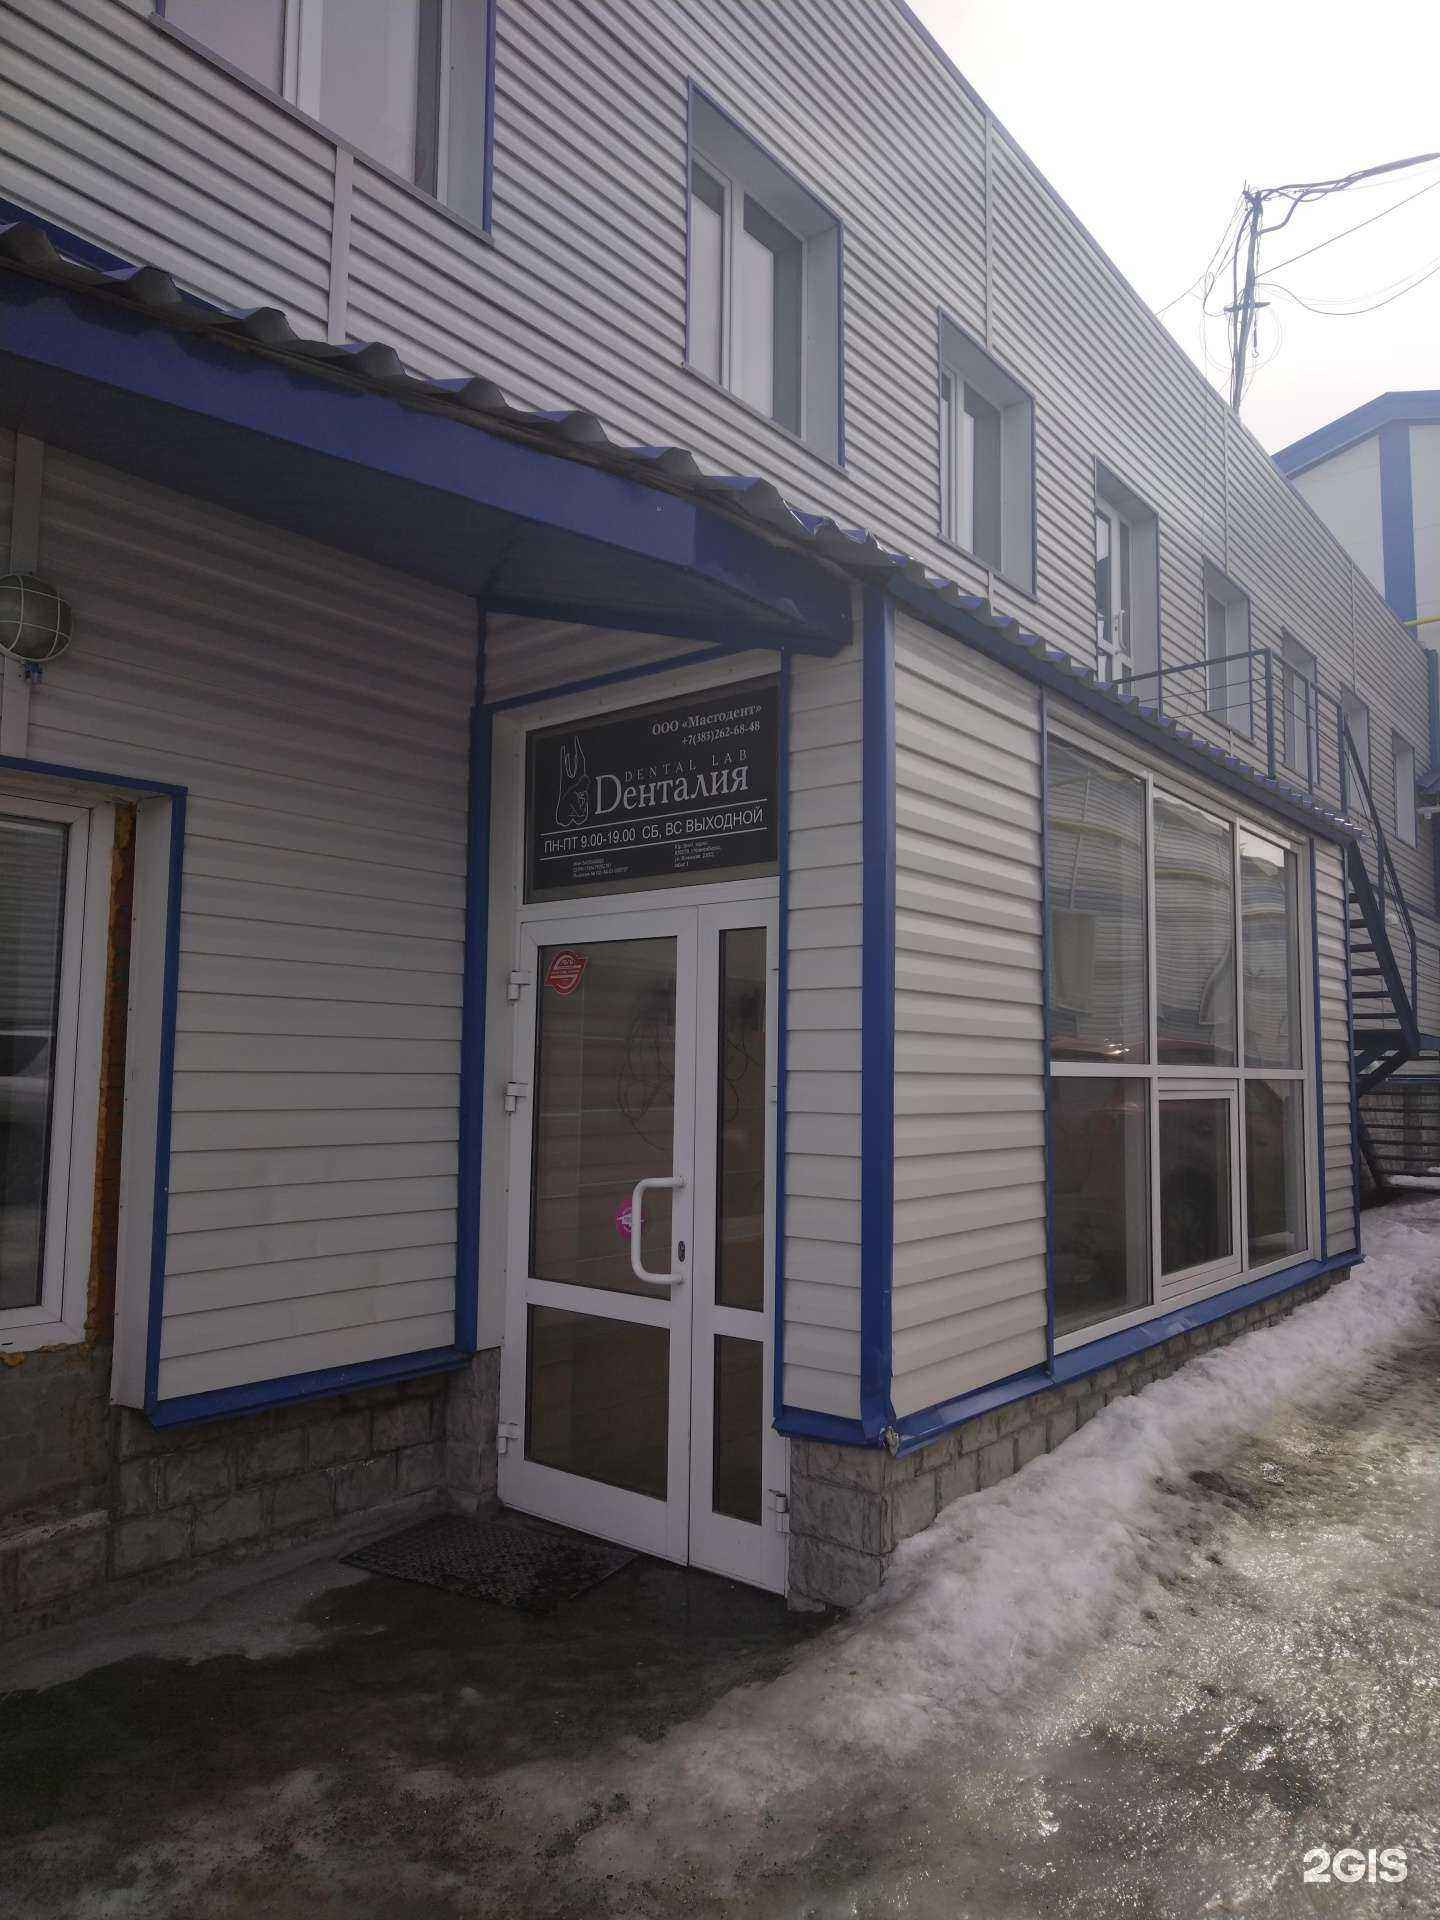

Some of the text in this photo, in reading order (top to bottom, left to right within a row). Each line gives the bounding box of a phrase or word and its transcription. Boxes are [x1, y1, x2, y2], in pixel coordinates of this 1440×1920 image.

[652, 704, 762, 735] ООО «Мастодент»
[625, 749, 747, 782] DENTAL LAB
[544, 806, 763, 853] ПН-ПТ 9.00-19.00 СБ, ВС ВЫХОДНОЙ
